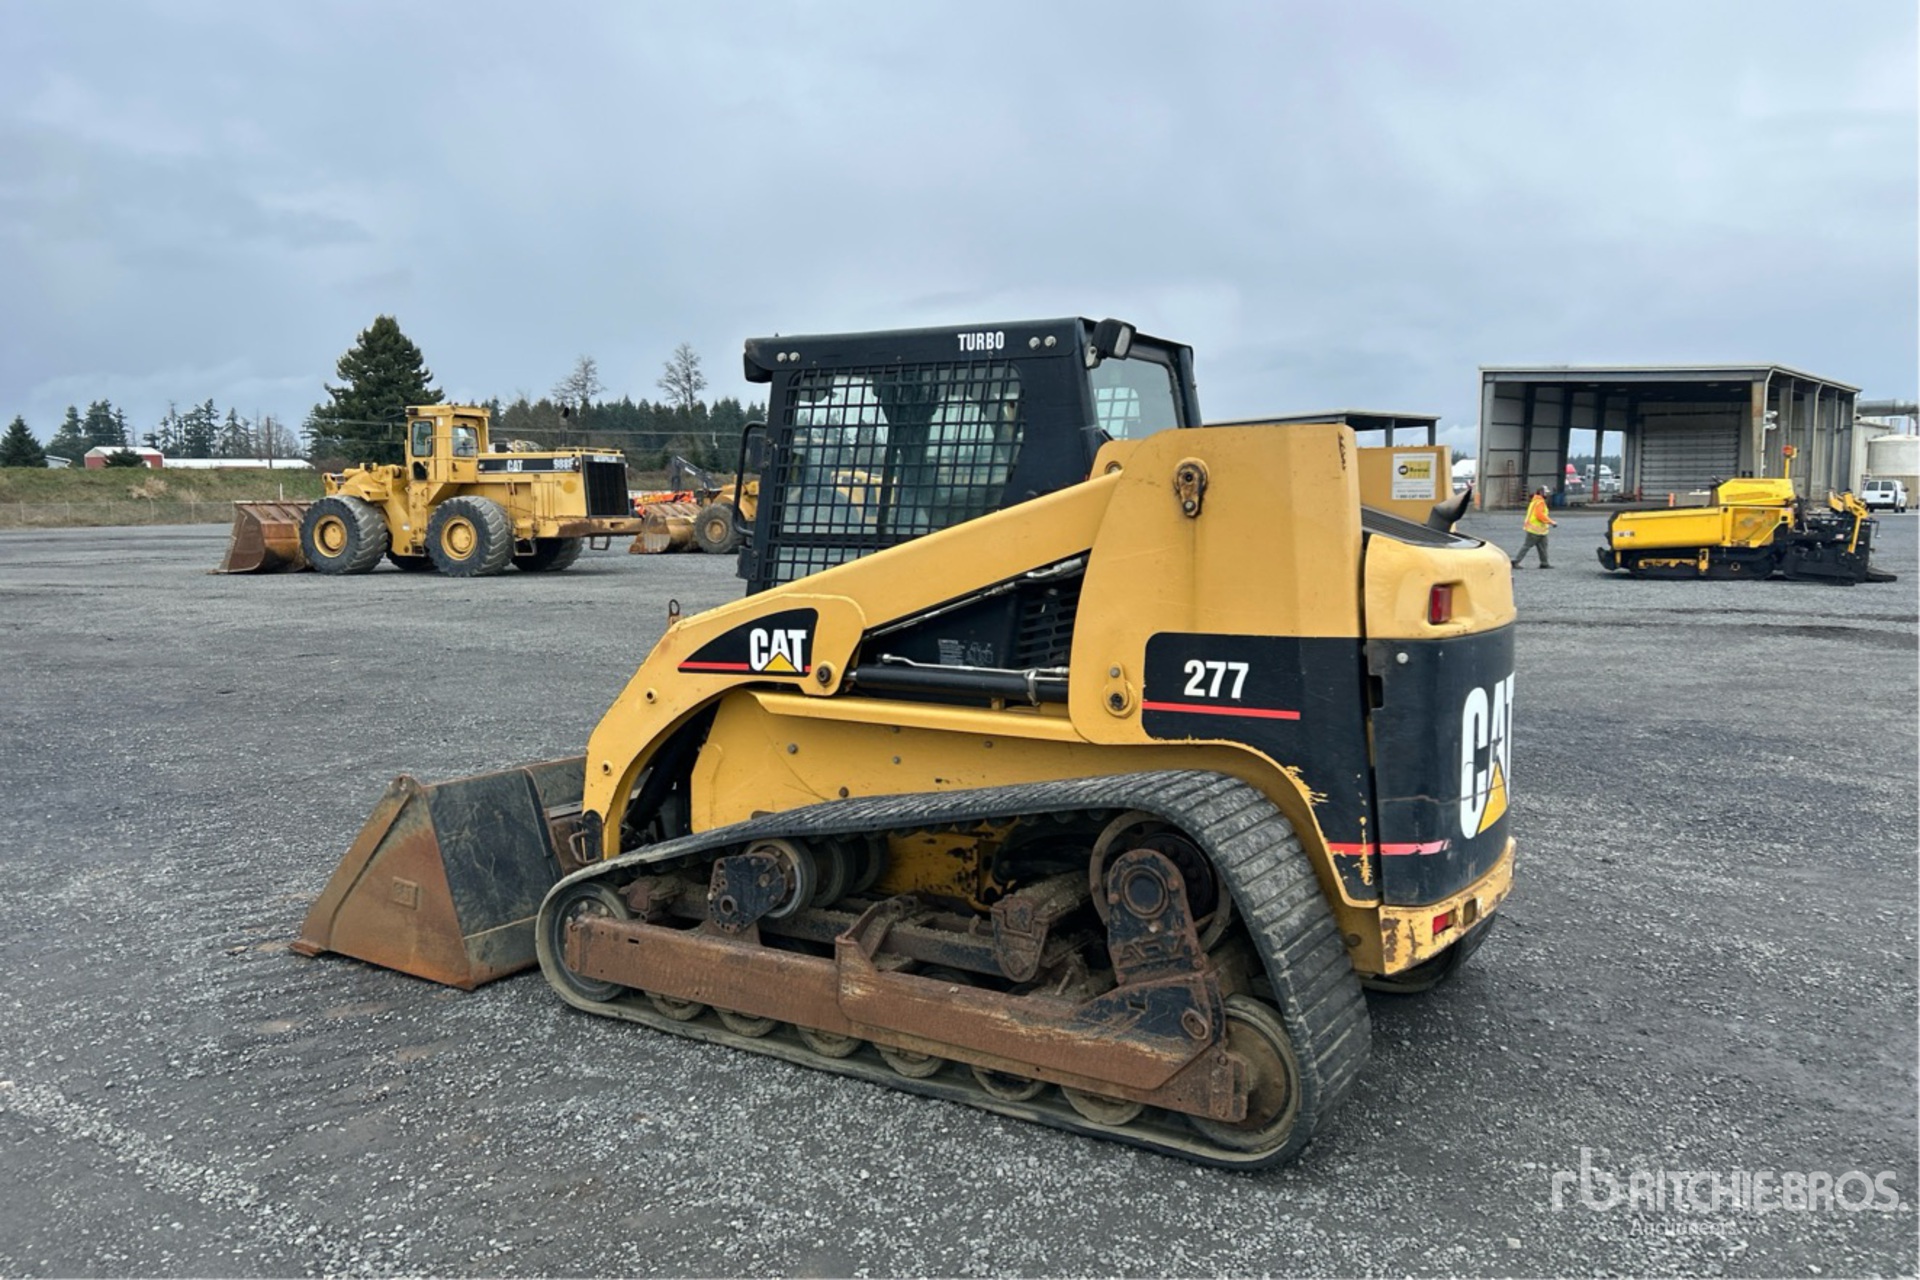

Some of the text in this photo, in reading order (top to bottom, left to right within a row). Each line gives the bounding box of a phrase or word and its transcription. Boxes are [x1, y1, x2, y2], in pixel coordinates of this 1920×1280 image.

[957, 331, 1005, 351] TURBO
[507, 459, 524, 472] CAT
[750, 628, 807, 672] CAT
[1184, 660, 1249, 699] 277
[1460, 671, 1515, 839] CAT
